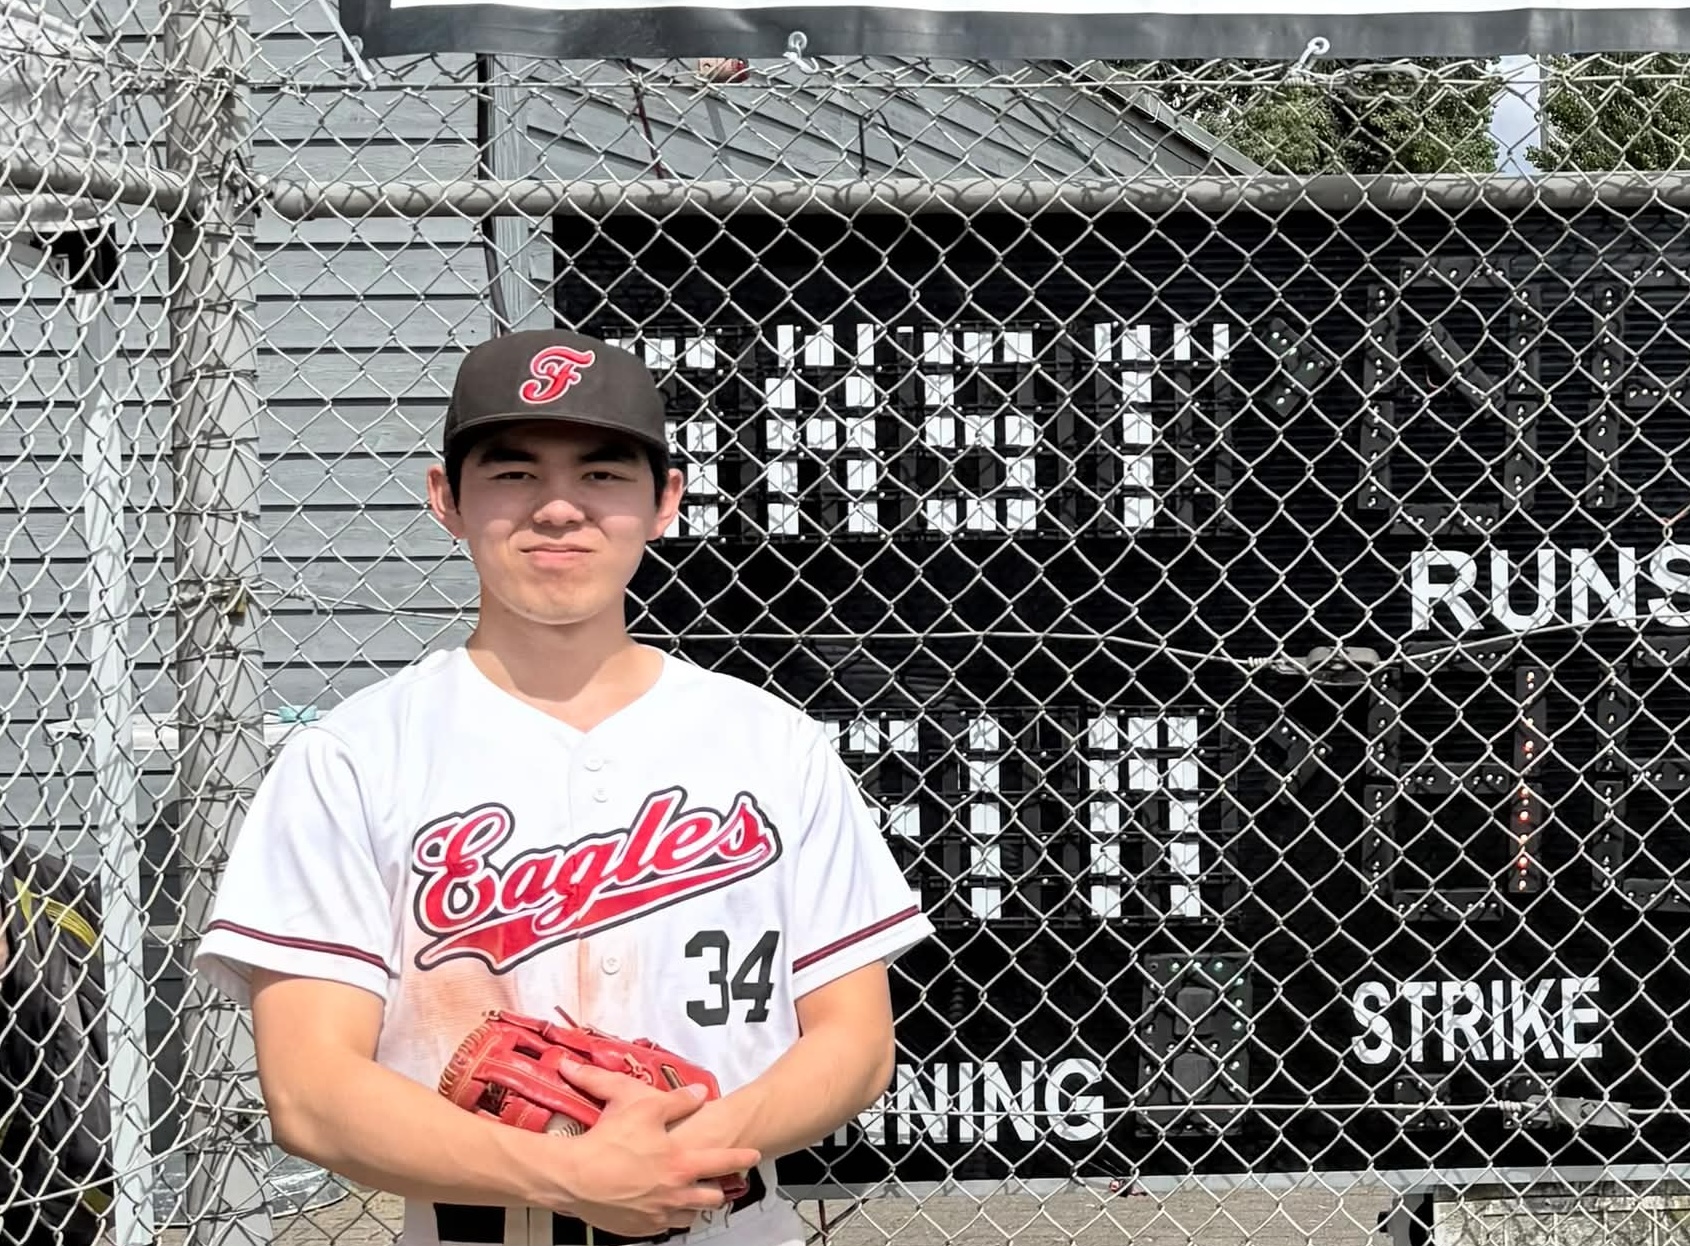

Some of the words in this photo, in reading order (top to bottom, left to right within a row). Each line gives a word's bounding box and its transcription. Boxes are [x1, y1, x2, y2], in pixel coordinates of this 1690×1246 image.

[519, 345, 596, 404] F
[412, 786, 782, 950] Eagles
[685, 930, 780, 1026] 34
[1352, 976, 1604, 1064] STRIKE
[810, 1058, 1104, 1147] NNING
